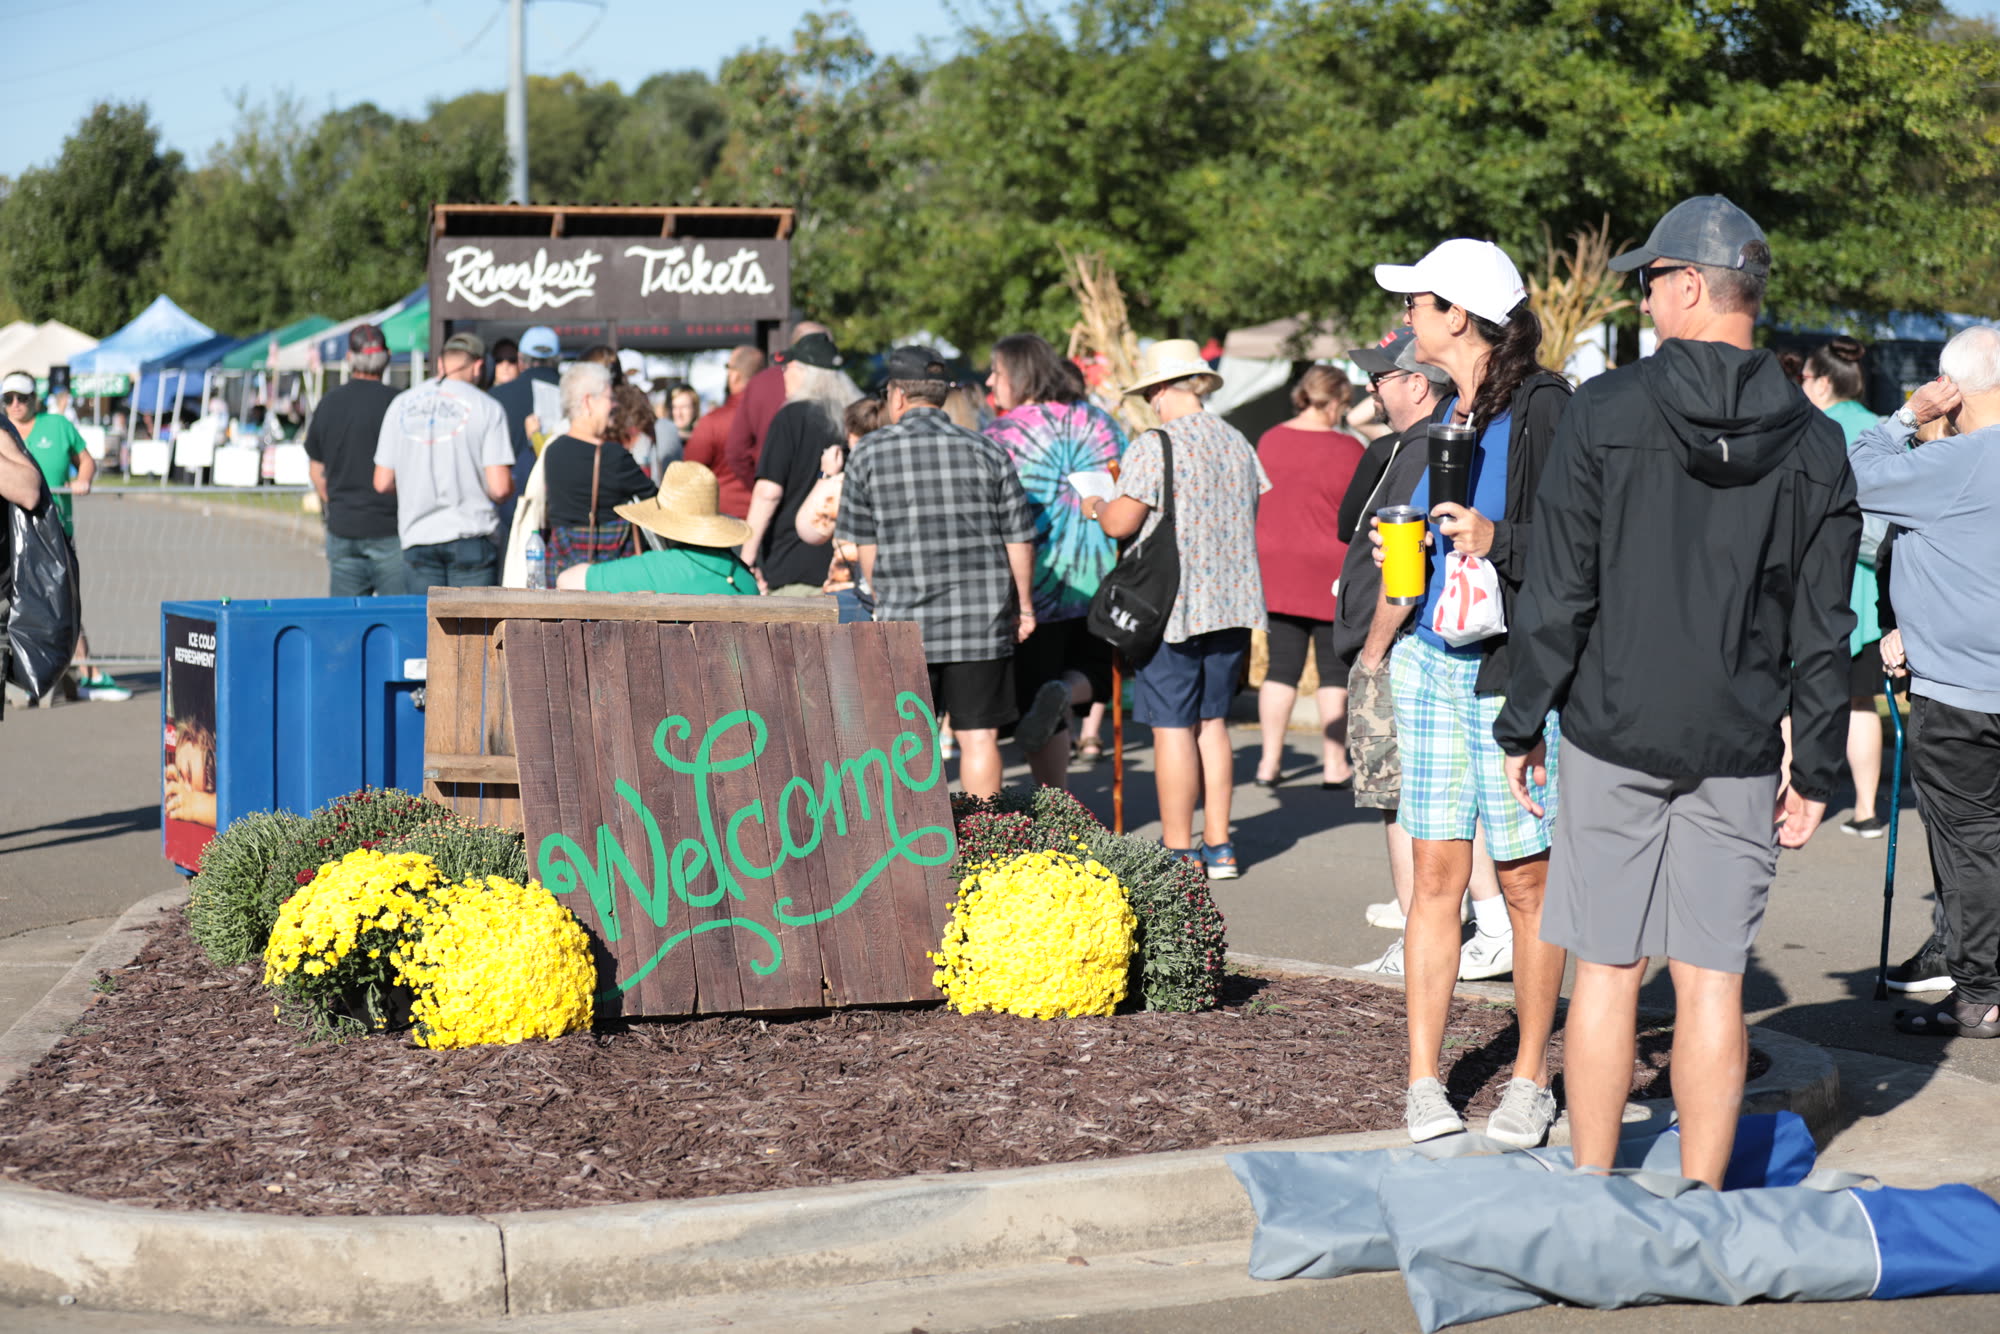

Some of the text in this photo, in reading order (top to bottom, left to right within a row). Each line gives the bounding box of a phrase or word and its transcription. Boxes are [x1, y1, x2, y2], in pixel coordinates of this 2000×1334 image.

[445, 244, 775, 312] Riverfest Tickets
[175, 646, 215, 668] REFRESHMENT
[188, 632, 216, 651] ICE COLD
[537, 691, 955, 942] Welcome
